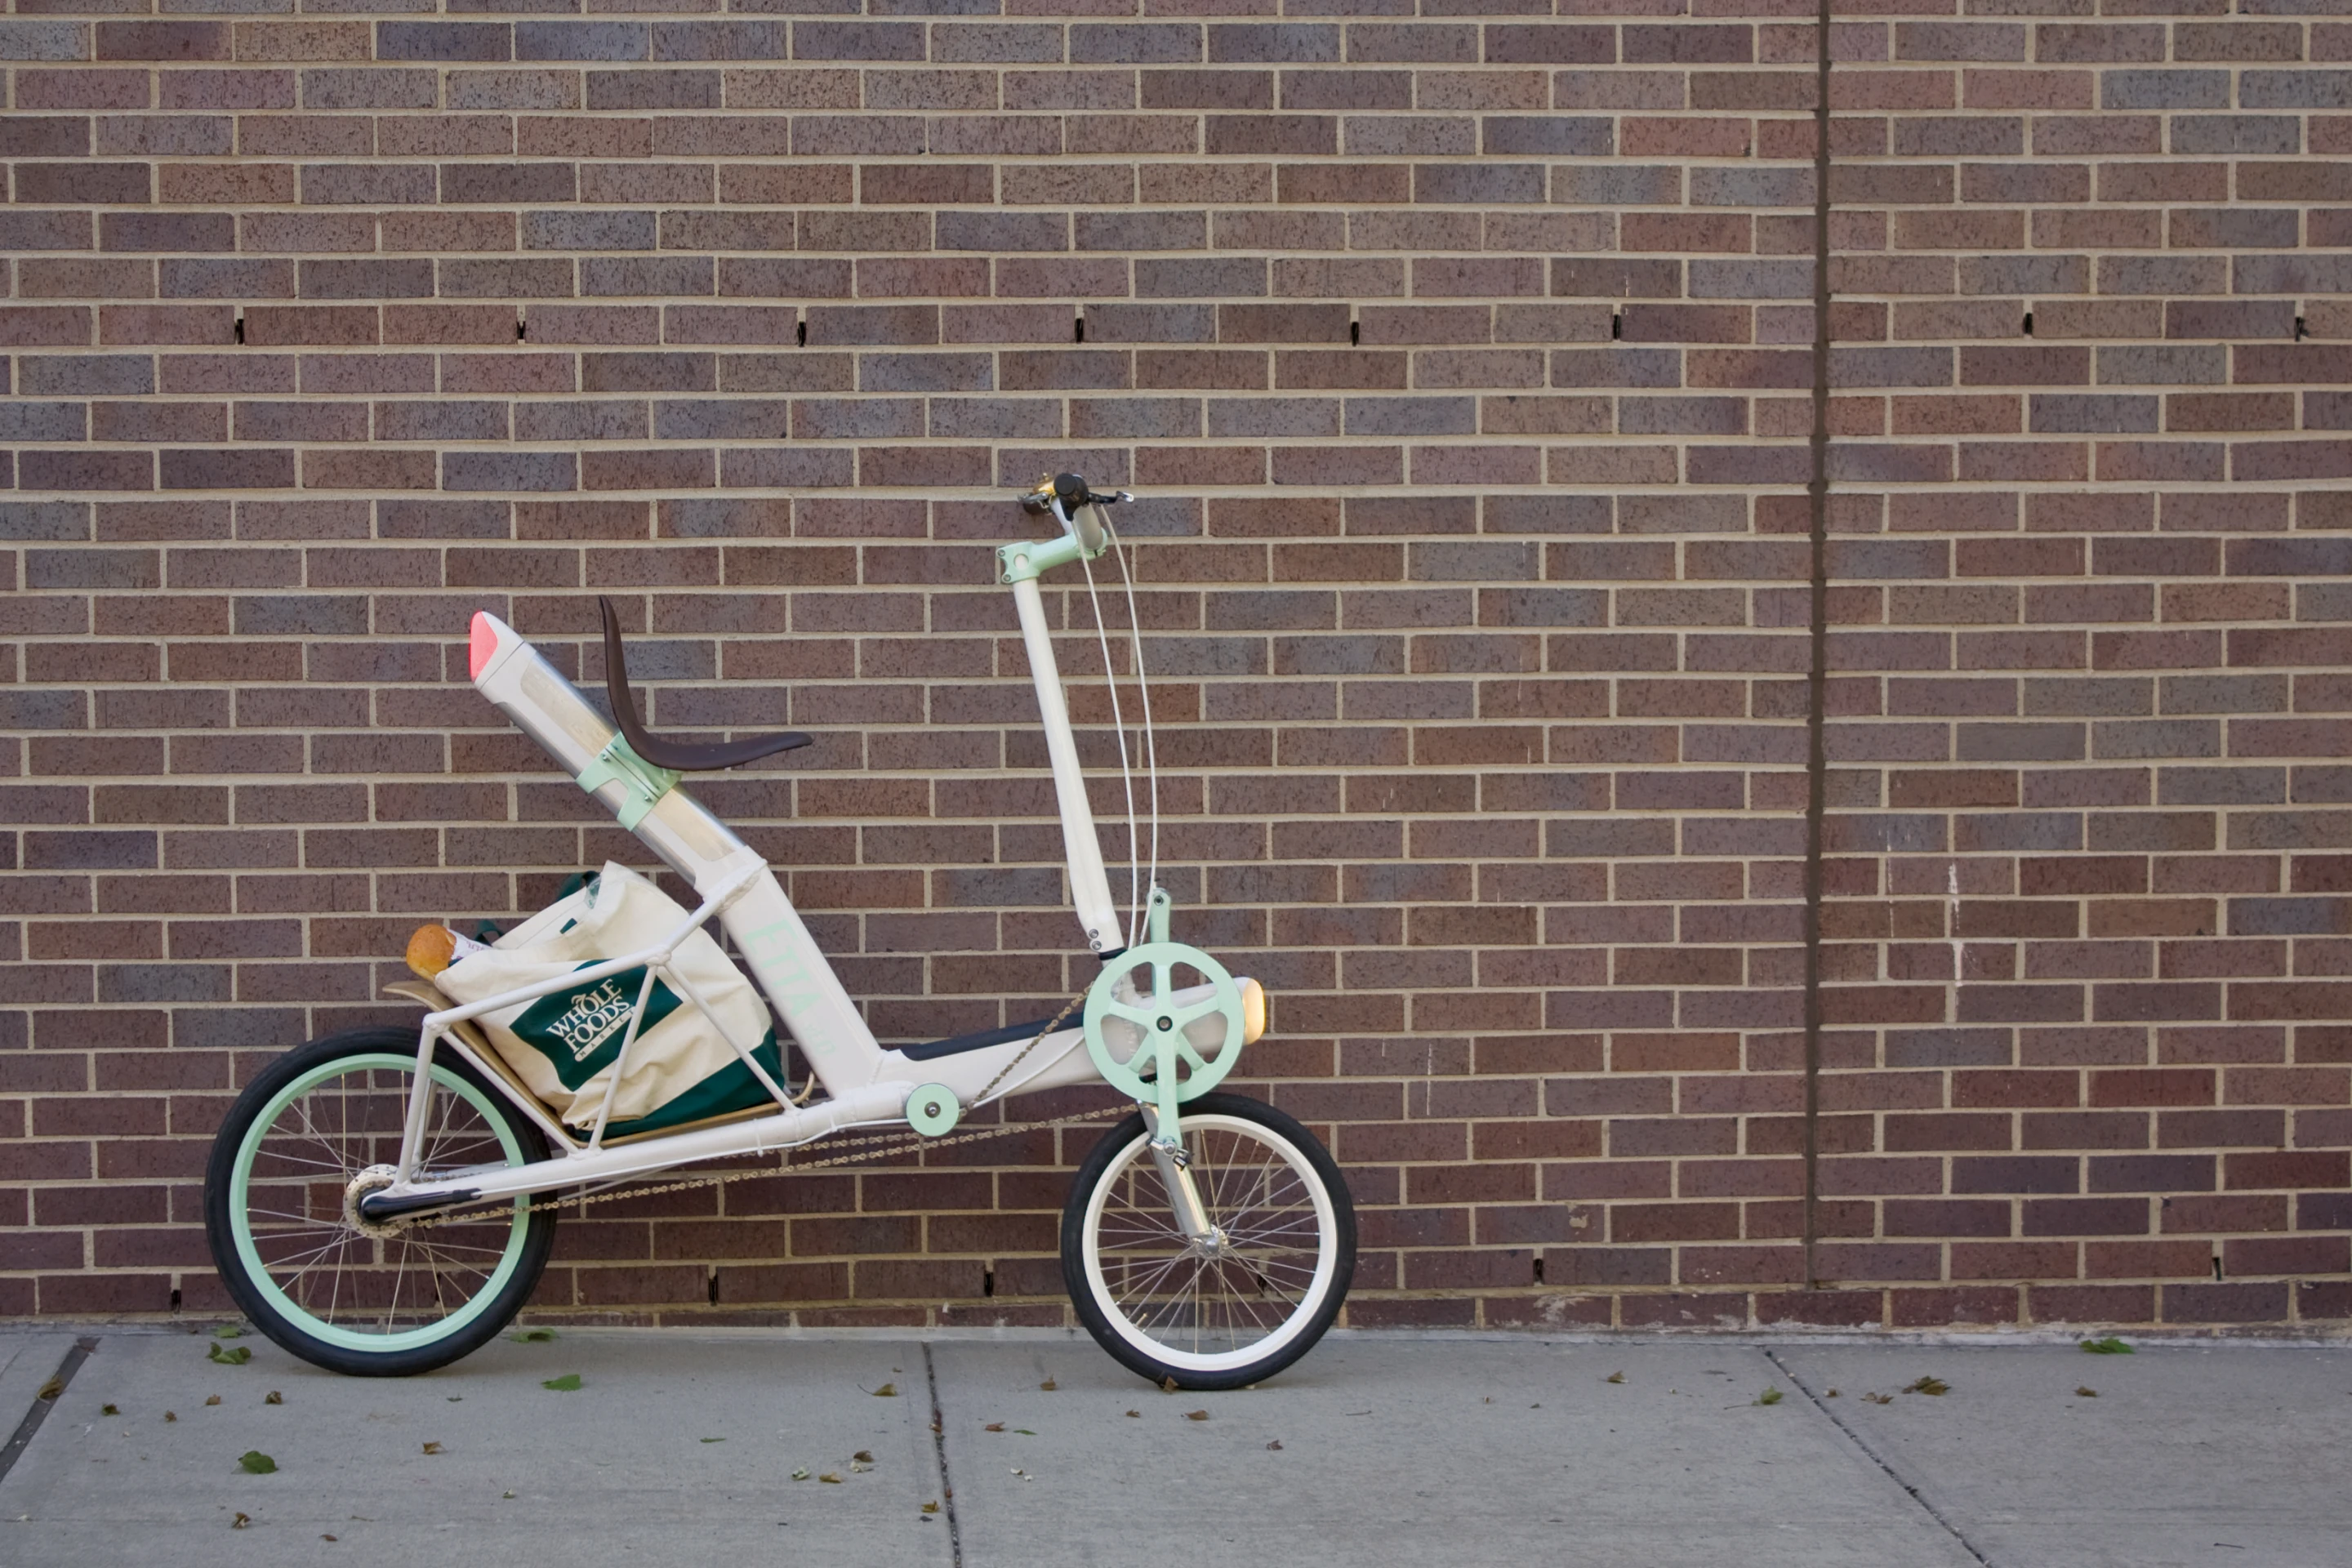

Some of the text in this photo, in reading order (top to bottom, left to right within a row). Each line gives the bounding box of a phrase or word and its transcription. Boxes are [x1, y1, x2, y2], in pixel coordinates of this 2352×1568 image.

[743, 918, 822, 1018] ETTA
[546, 978, 621, 1037] WHOLE
[564, 996, 630, 1054] FOODS
